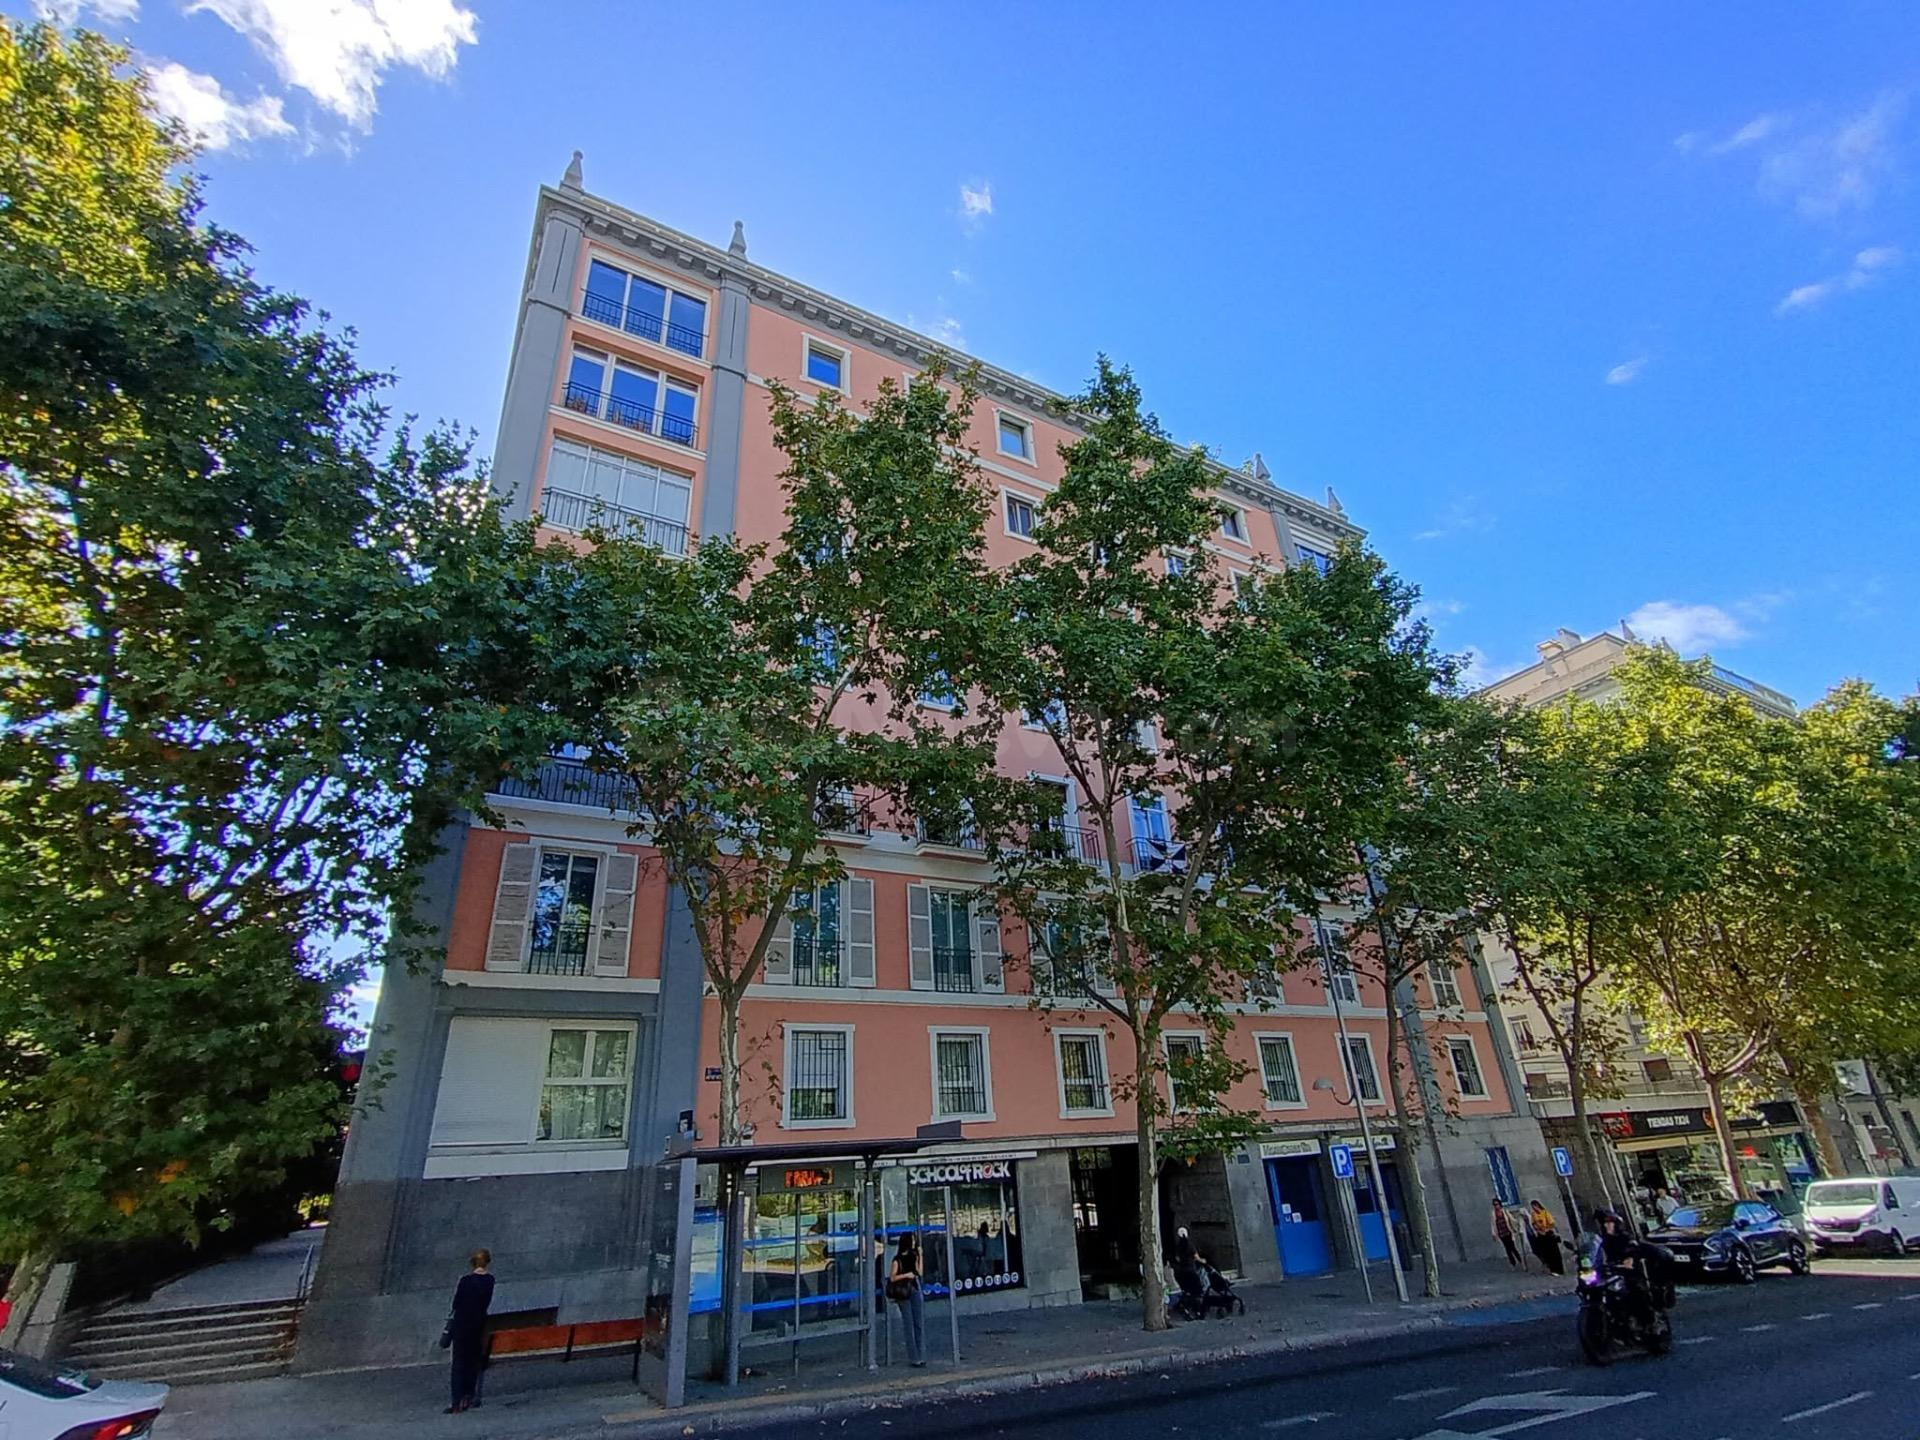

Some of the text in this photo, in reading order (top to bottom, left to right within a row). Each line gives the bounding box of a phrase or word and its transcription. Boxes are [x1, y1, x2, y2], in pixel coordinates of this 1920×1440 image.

[909, 1164, 963, 1185] SCHOOL
[972, 1161, 1011, 1180] ROCK
[1334, 1150, 1347, 1173] P
[1556, 1152, 1566, 1172] P
